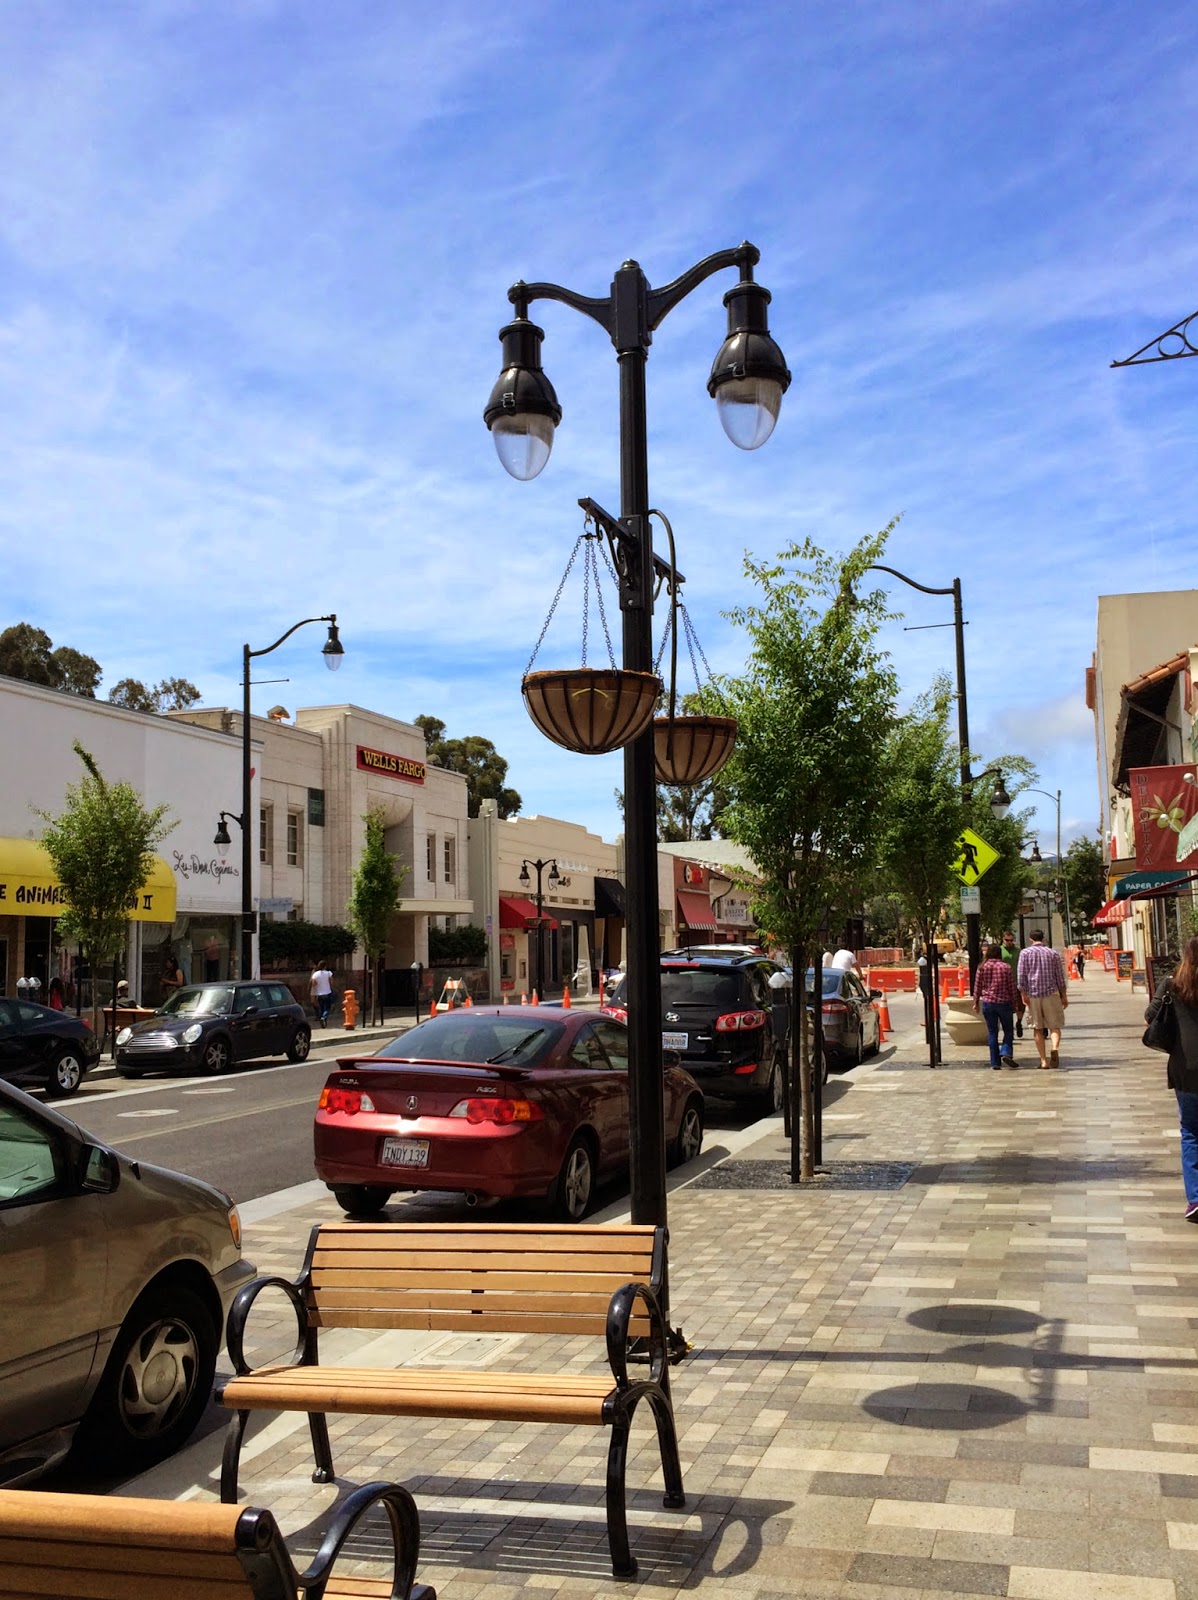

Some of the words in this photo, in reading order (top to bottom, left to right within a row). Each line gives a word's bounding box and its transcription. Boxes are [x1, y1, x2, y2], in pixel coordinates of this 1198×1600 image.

[363, 750, 397, 772] WELLS
[398, 759, 427, 779] FARGO
[1125, 882, 1152, 890] PAPER
[385, 1146, 407, 1161] INDY
[409, 1149, 426, 1163] 139
